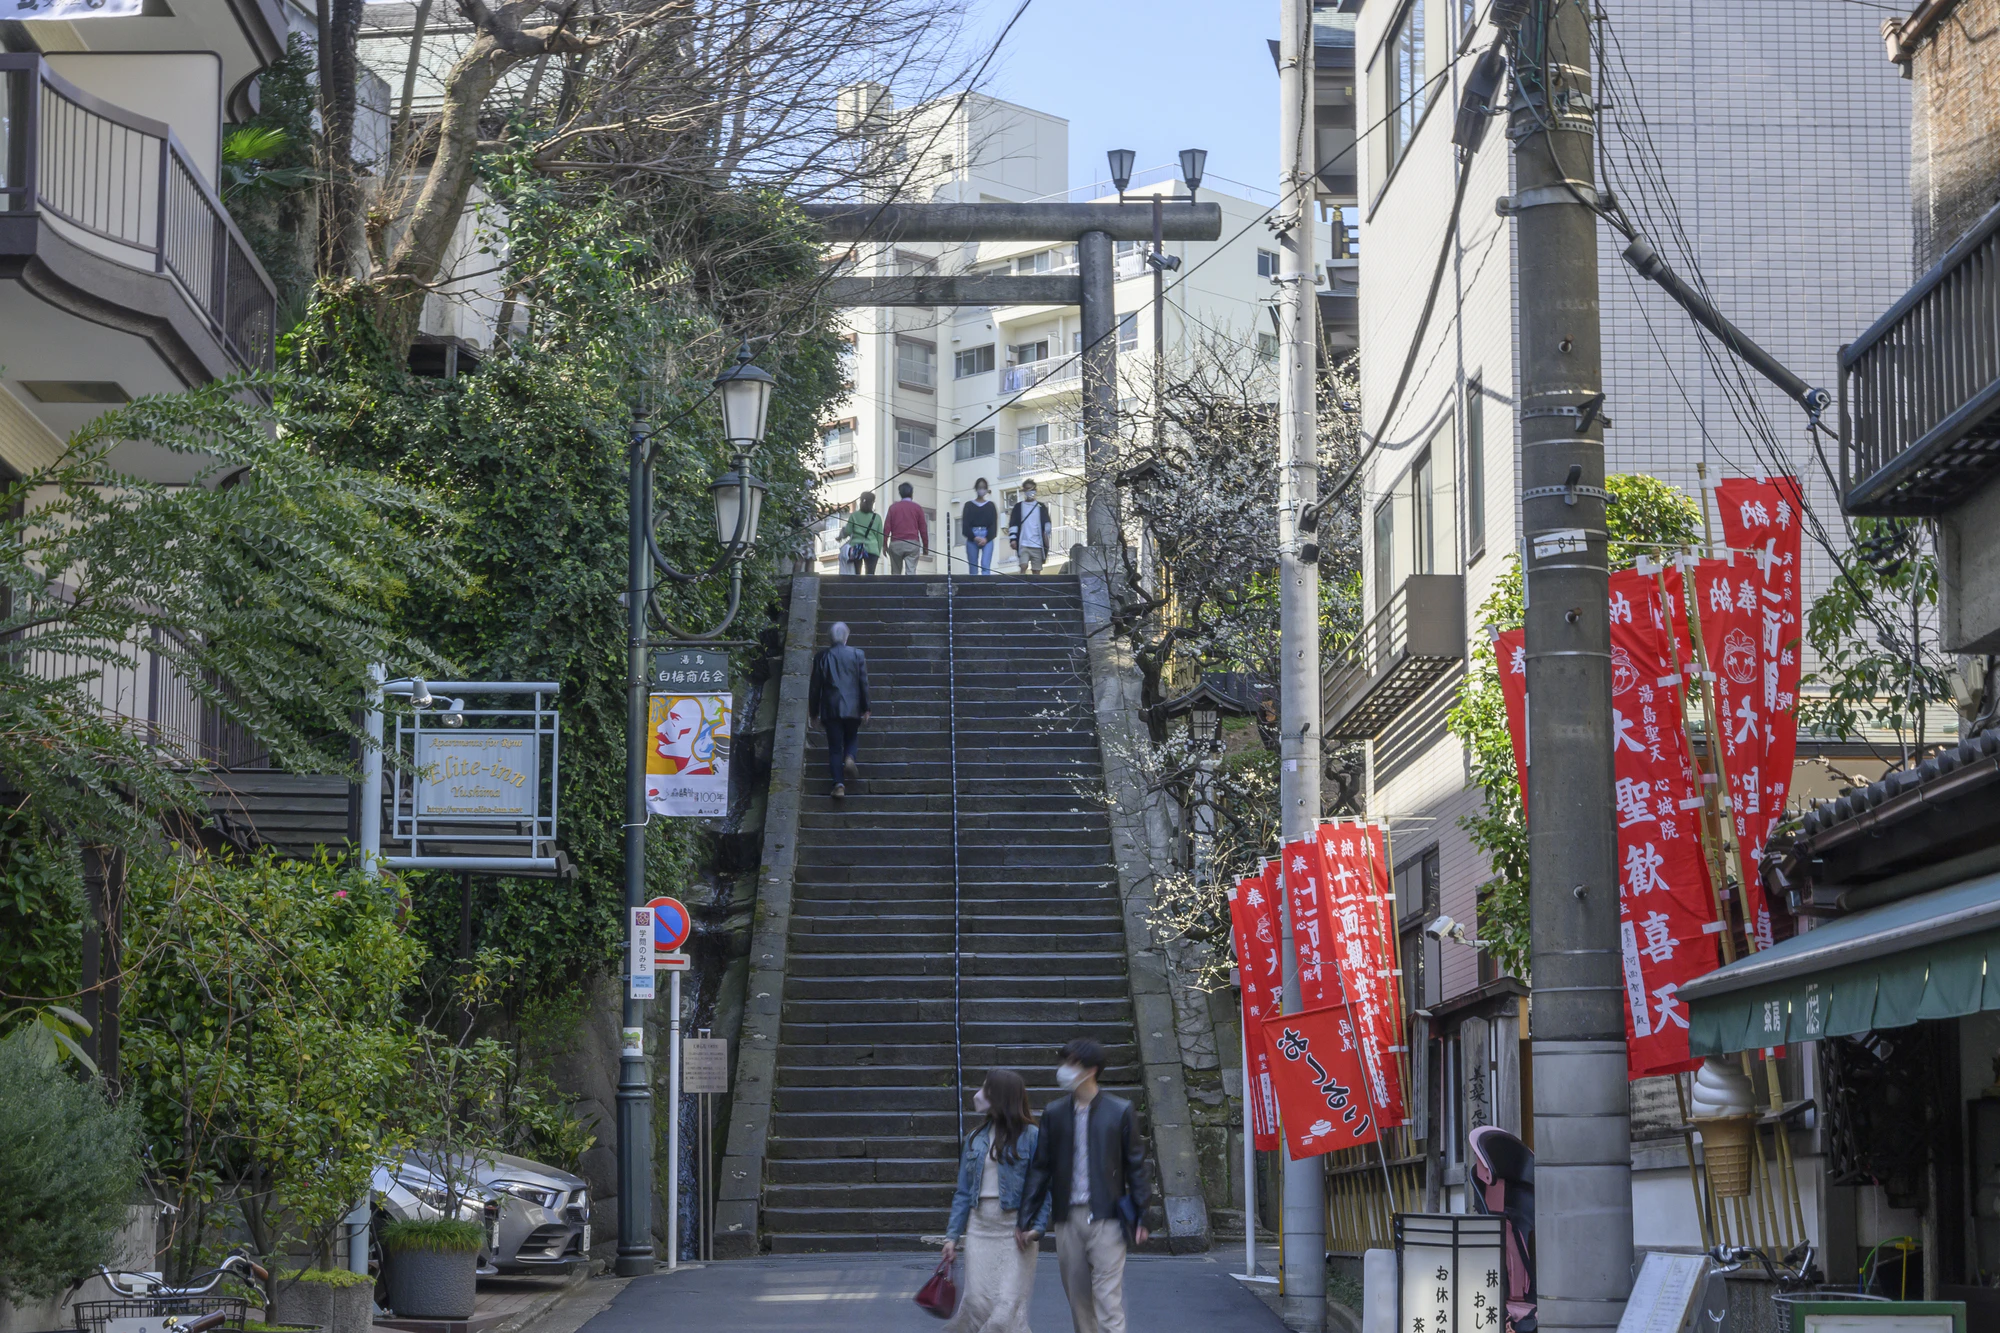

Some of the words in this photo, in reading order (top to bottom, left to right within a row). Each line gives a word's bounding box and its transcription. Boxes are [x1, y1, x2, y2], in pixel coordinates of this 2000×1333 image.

[680, 655, 705, 665] 湯島
[658, 669, 725, 683] 白梅商店会
[429, 737, 483, 750] Apartments
[483, 737, 499, 750] for
[501, 738, 523, 748] Rent
[424, 755, 527, 788] Elite-inn
[1637, 685, 1666, 763] 湯島聖天
[1654, 778, 1680, 841] 心城院
[450, 786, 501, 798] Yushima
[1324, 839, 1355, 860] 奉納
[1291, 855, 1308, 874] 奉
[1613, 708, 1690, 1035] 大聖歓喜天
[1246, 887, 1266, 909] 奉
[638, 929, 647, 972] 学問のみち
[1486, 1269, 1499, 1325] 抹茶
